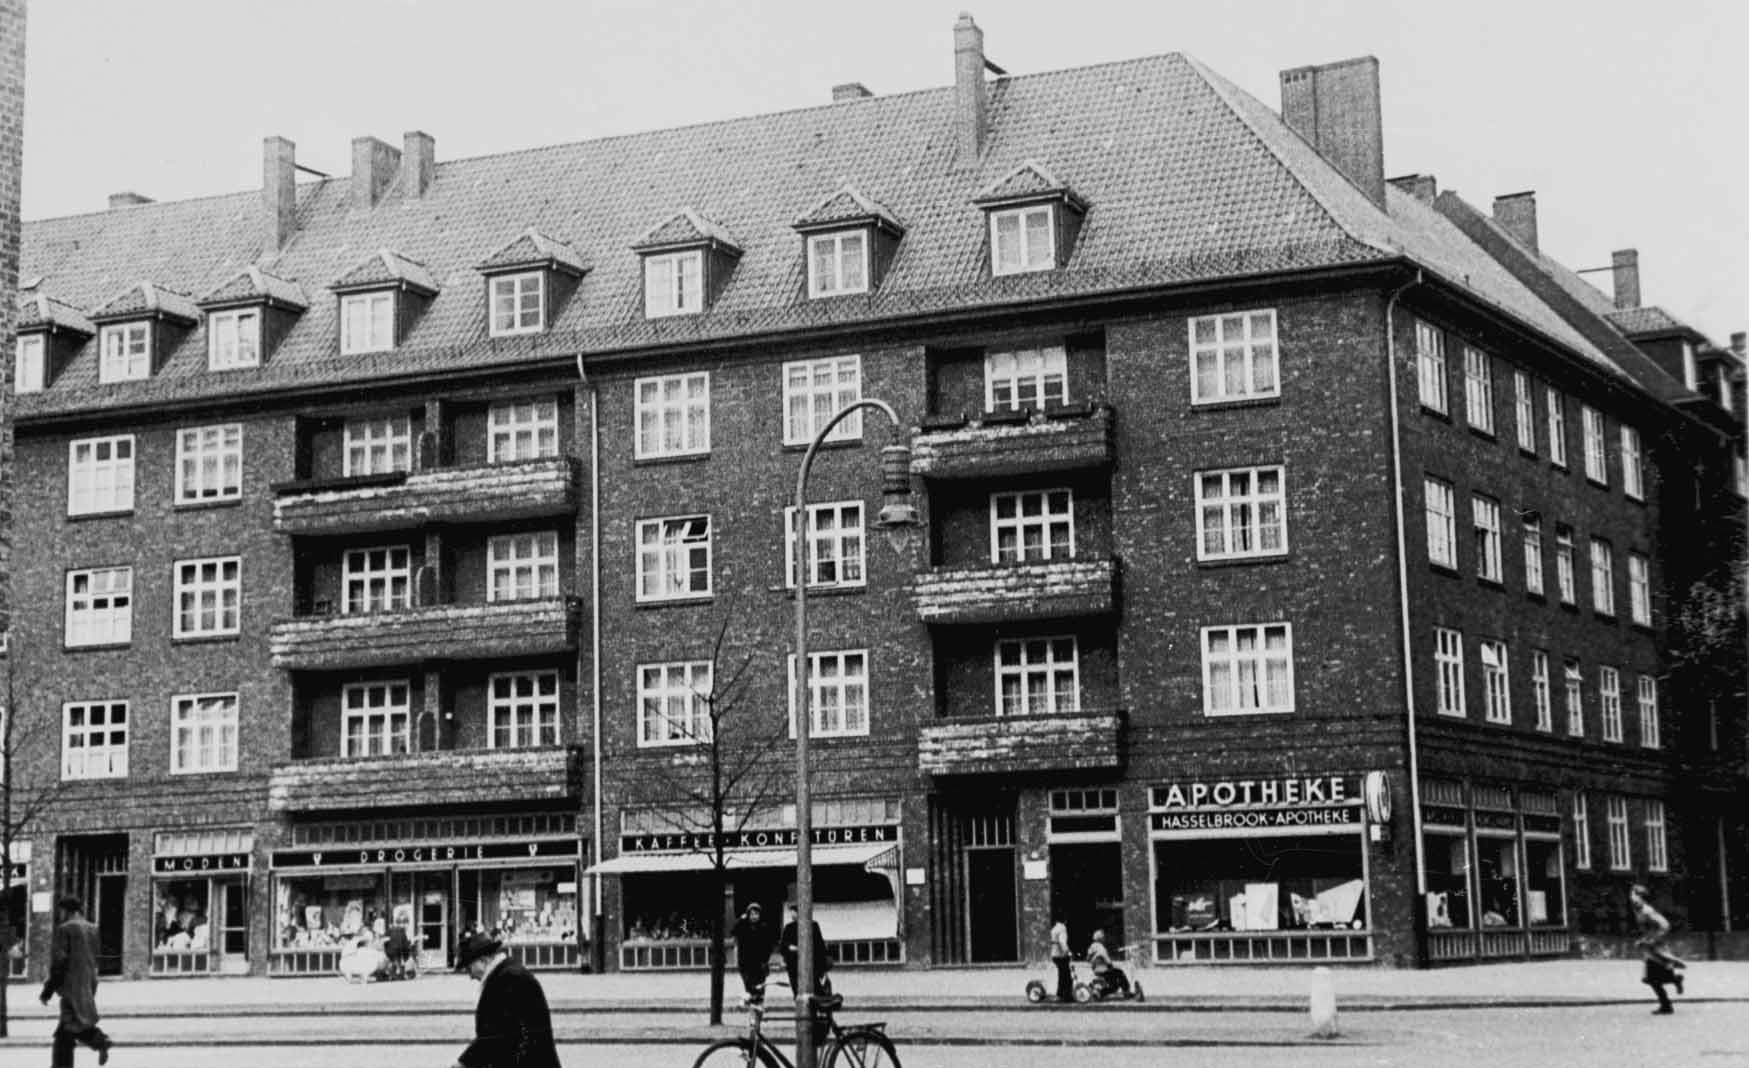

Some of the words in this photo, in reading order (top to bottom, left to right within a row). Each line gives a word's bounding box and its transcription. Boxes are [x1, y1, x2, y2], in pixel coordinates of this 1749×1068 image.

[1165, 777, 1345, 807] APOTHEKE
[1162, 809, 1350, 828] HASSELBROOK-APOTHEKE
[635, 834, 715, 850] KAFFEE
[164, 856, 241, 870] MODEN
[360, 846, 483, 864] DROGERIE
